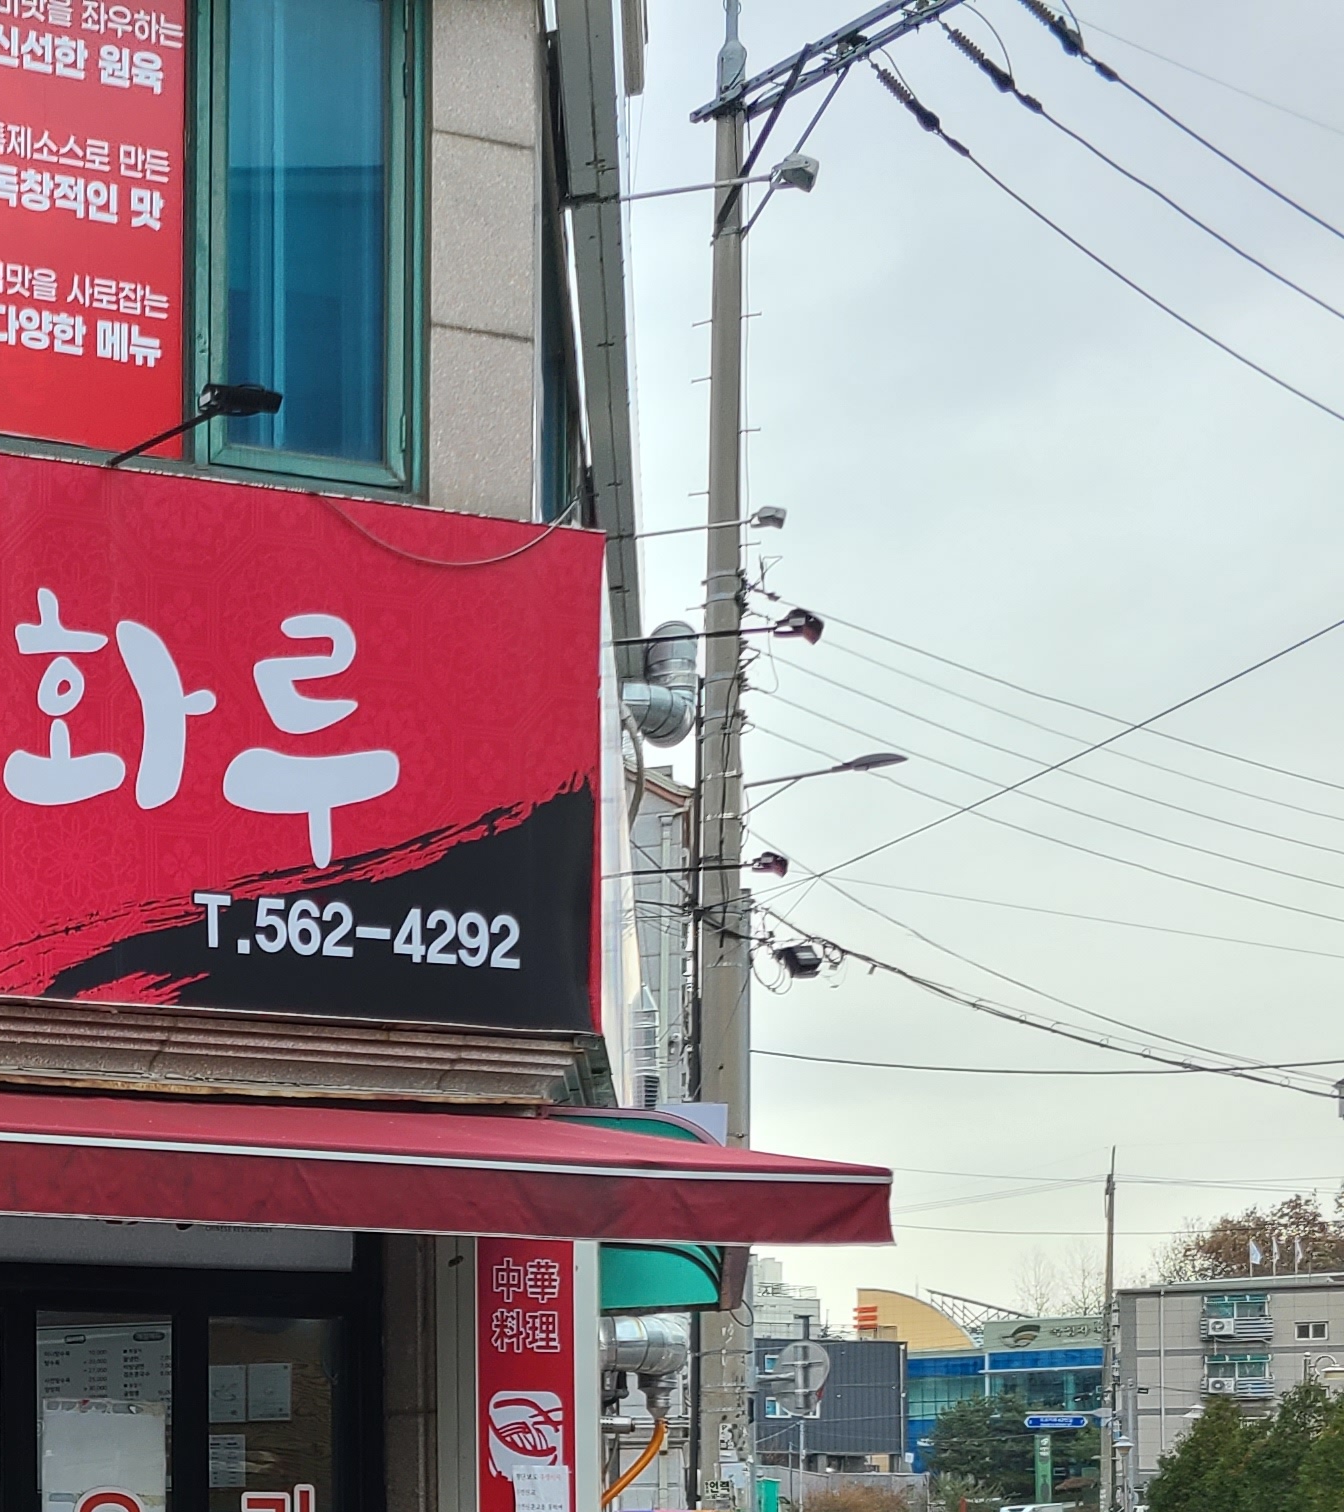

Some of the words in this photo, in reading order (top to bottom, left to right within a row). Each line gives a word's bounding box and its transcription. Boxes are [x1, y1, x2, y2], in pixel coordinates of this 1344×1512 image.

[81, 4, 184, 49] 좌우하는
[98, 43, 164, 95] 원육
[119, 143, 172, 183] 만든
[130, 187, 164, 231] 맛
[66, 274, 170, 319] 사로잡는
[96, 318, 162, 368] 메뉴
[193, 892, 522, 970] T.562-4292
[492, 1257, 561, 1303] 中華
[492, 1310, 561, 1354] 料理
